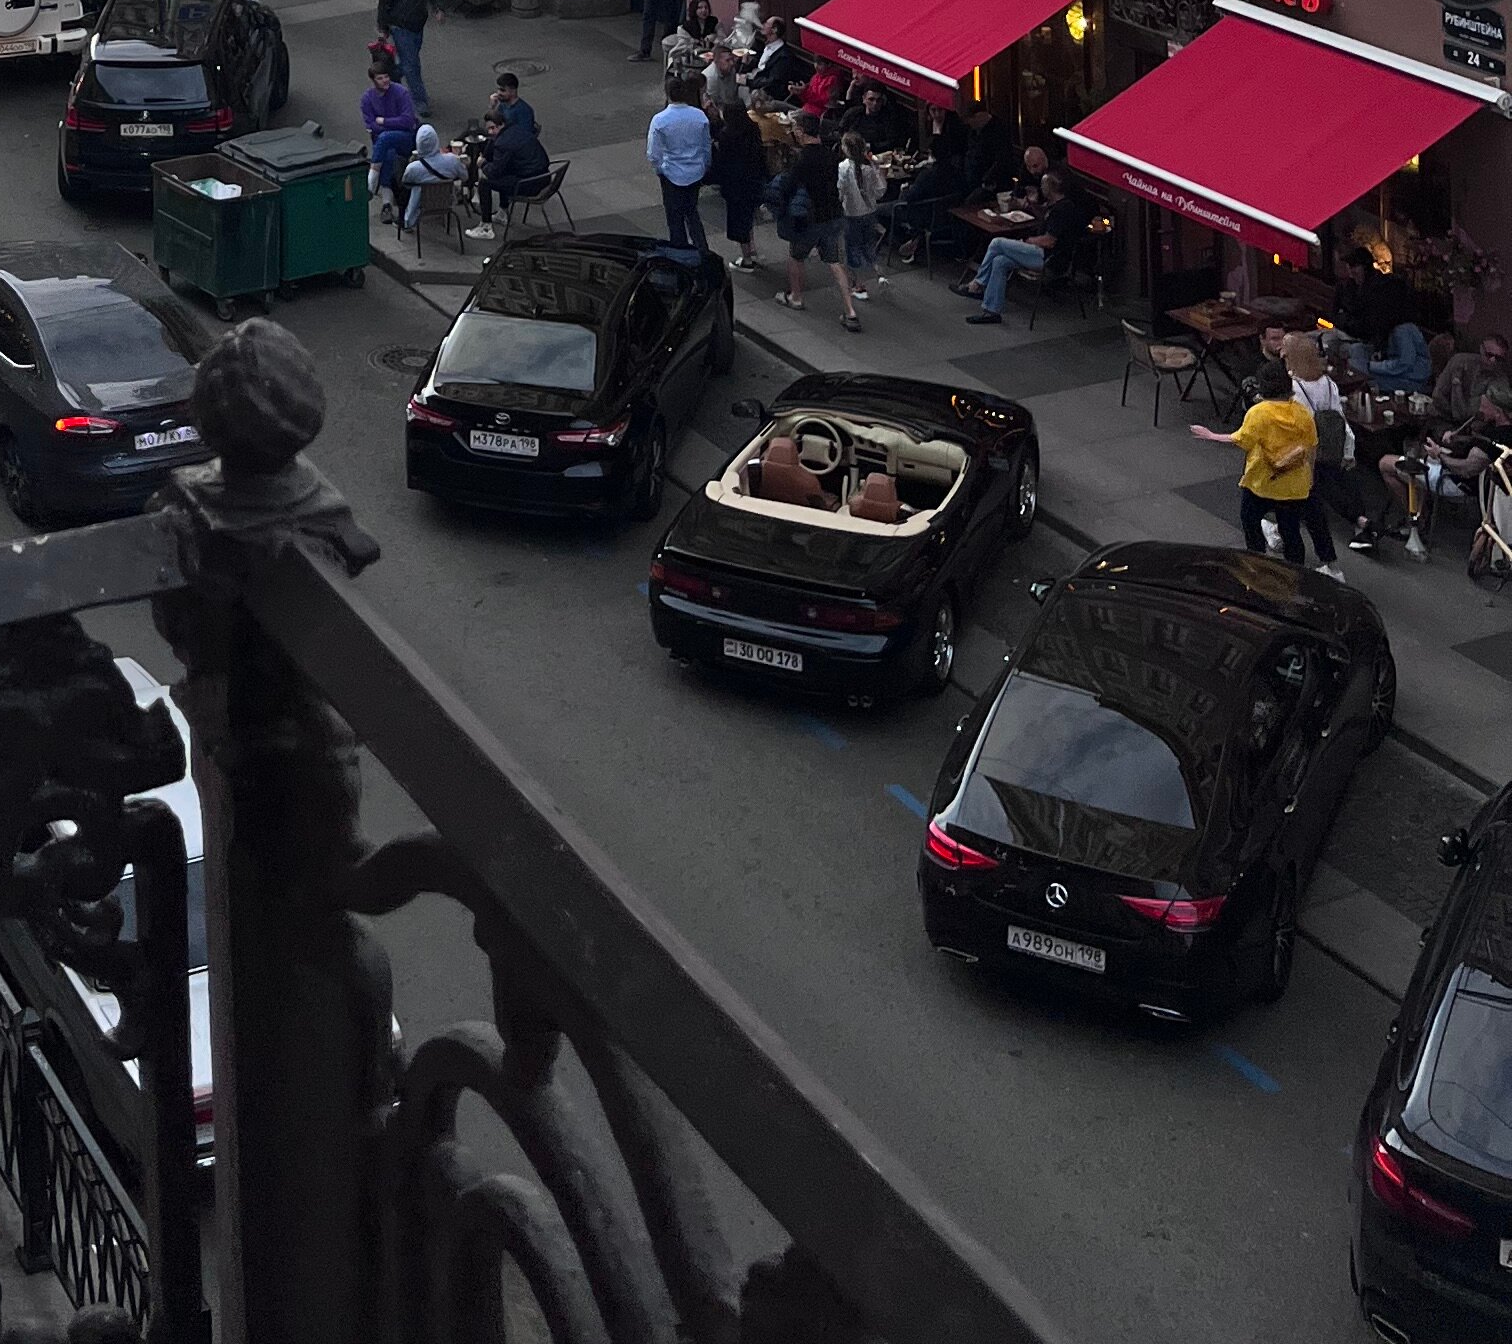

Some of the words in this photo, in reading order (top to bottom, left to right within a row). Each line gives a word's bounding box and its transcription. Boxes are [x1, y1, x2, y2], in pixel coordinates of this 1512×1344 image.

[1444, 11, 1504, 41] РУБИНШТЕЙНА
[1468, 51, 1480, 67] 24
[1122, 171, 1159, 197] Чайная
[1160, 191, 1174, 204] на
[1174, 195, 1242, 233] Рубинштейна
